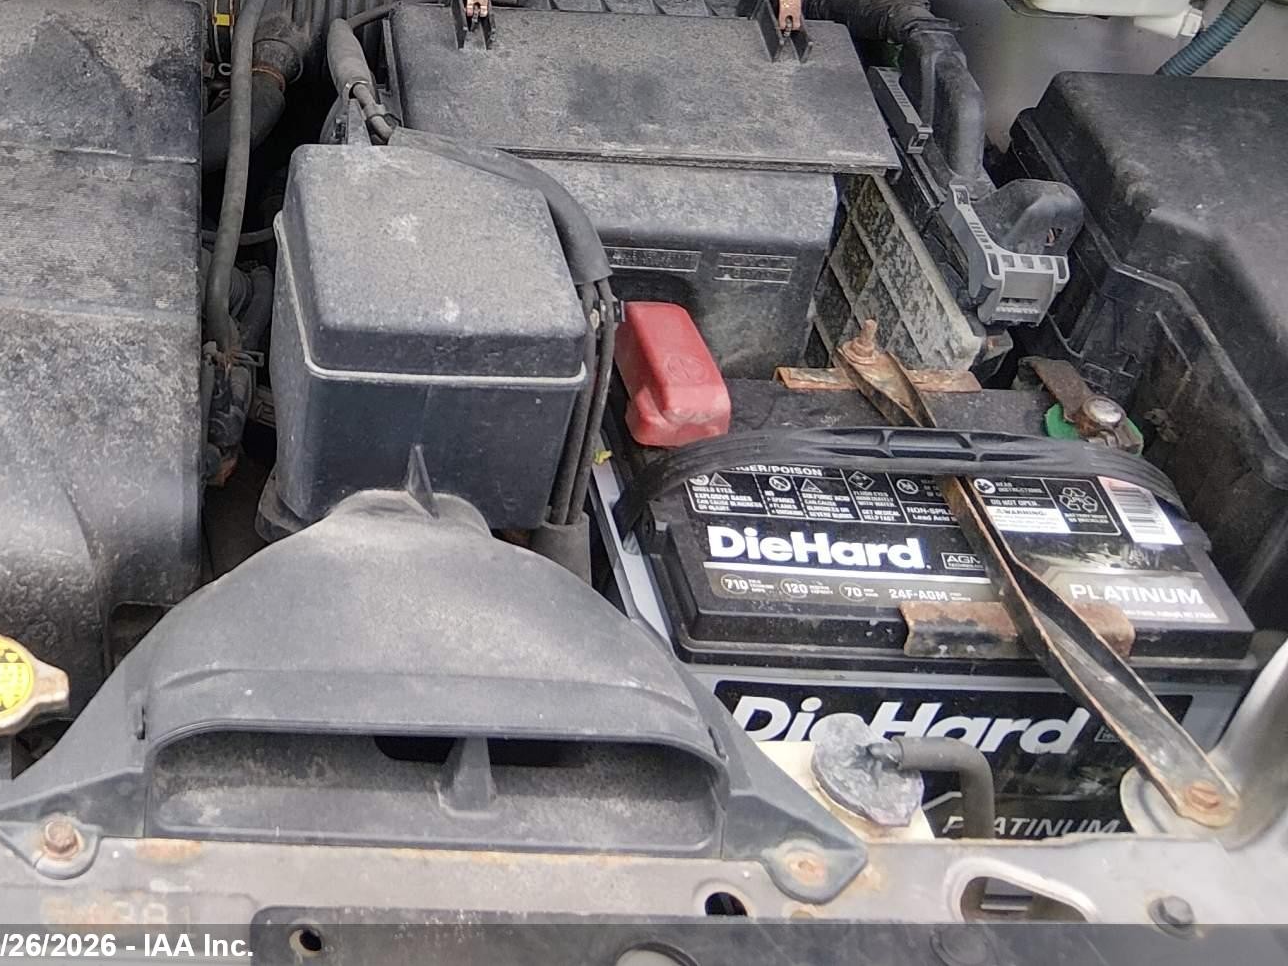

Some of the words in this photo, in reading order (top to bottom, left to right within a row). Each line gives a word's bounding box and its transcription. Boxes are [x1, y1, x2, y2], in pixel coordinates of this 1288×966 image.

[707, 524, 926, 570] DieHard
[724, 578, 749, 590] 710
[784, 582, 809, 594] 120
[844, 586, 862, 597] 70
[1069, 583, 1205, 605] PLATINUM
[942, 815, 1121, 837] PATINUM
